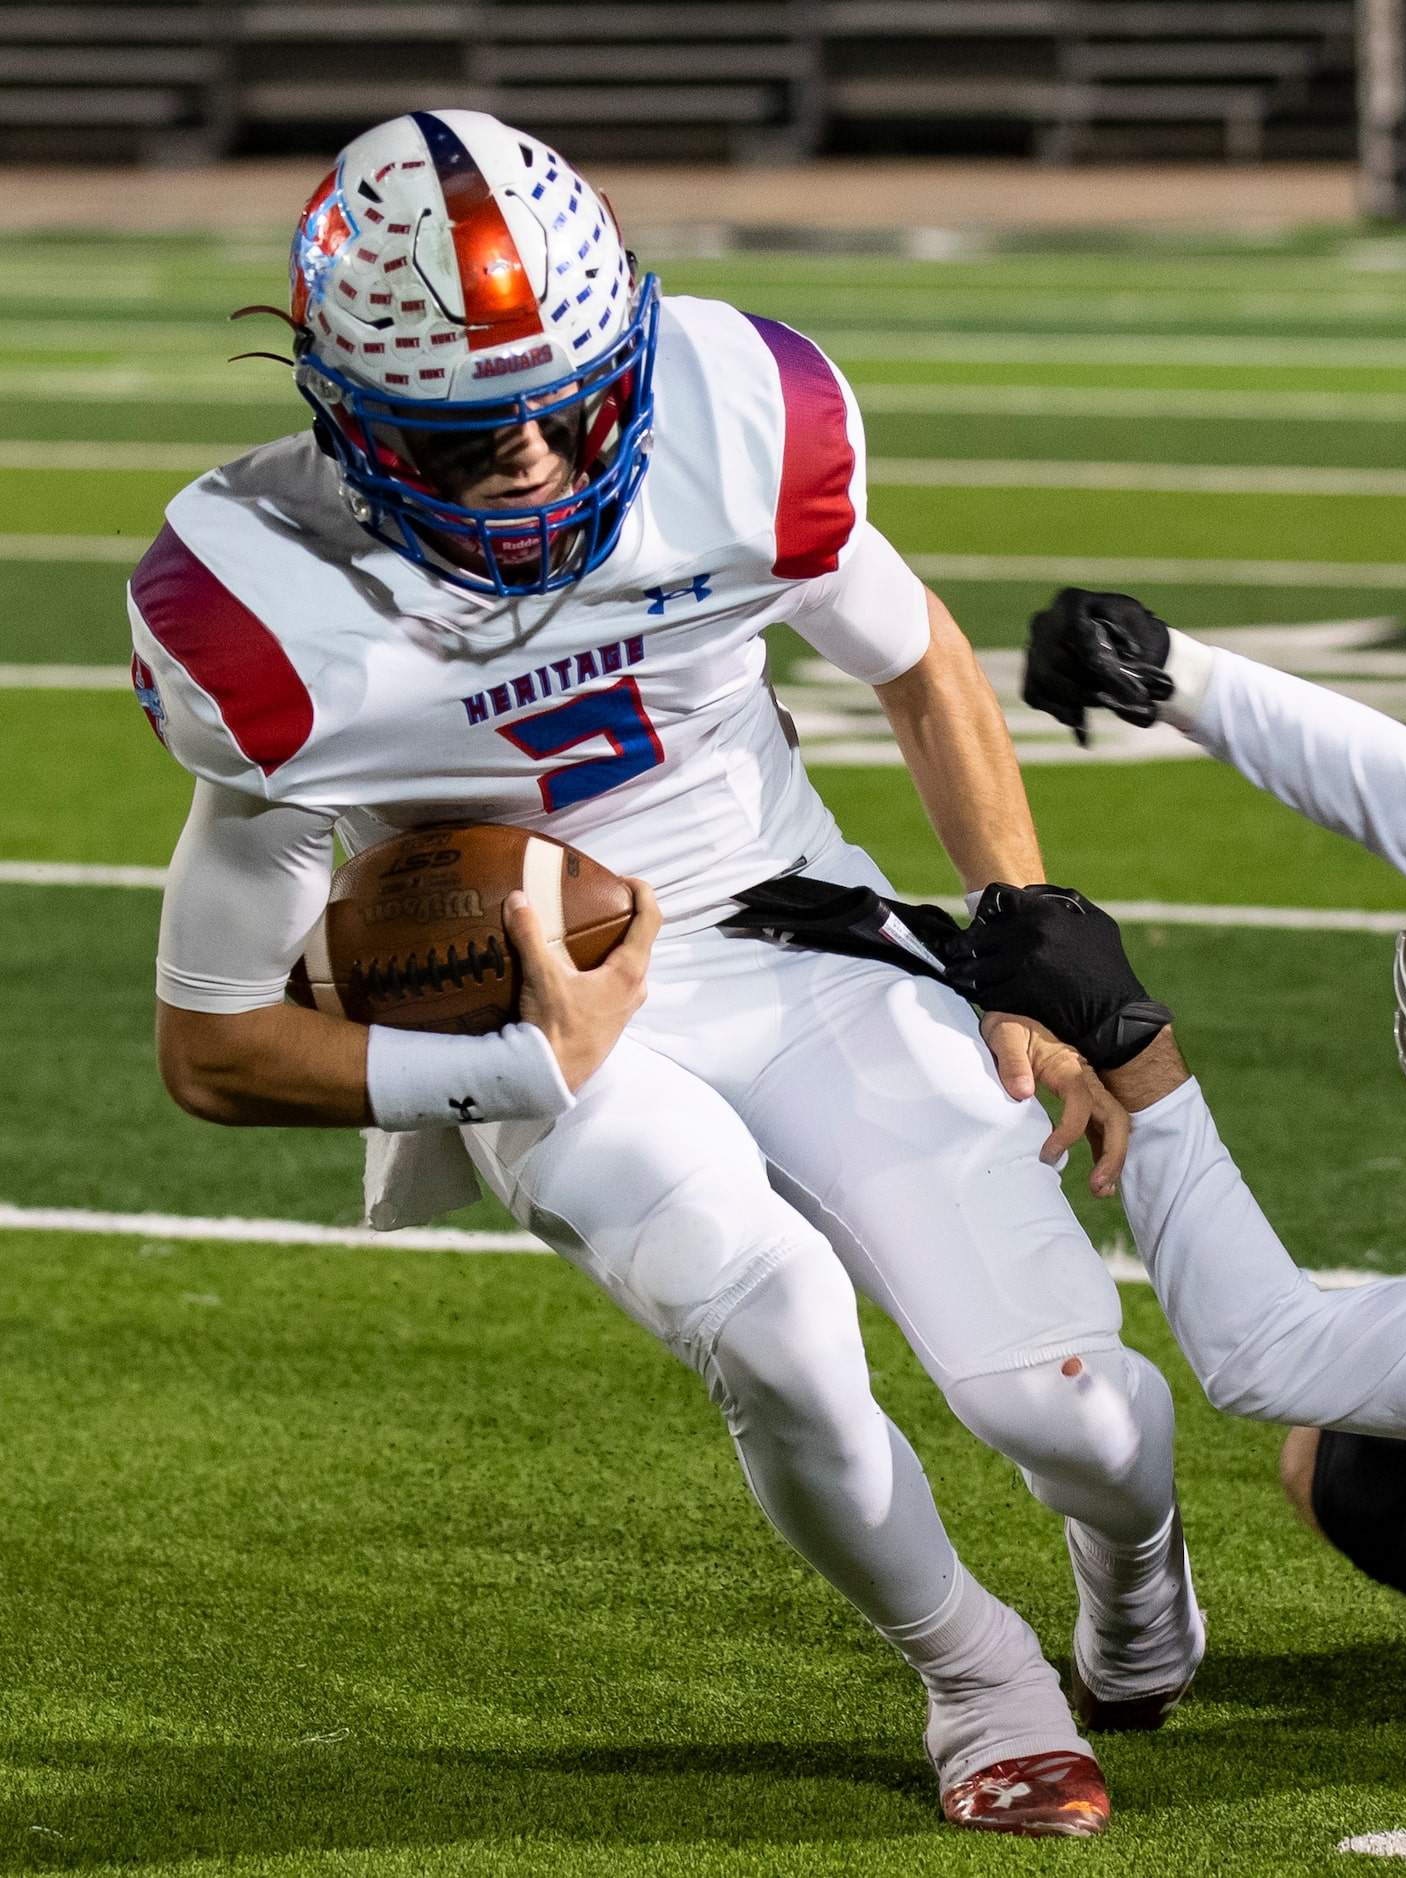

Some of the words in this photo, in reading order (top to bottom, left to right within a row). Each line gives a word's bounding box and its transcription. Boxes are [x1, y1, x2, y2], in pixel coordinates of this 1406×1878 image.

[472, 344, 553, 379] JAGUARS
[502, 538, 541, 550] Ridde
[460, 634, 645, 726] HERITAGE
